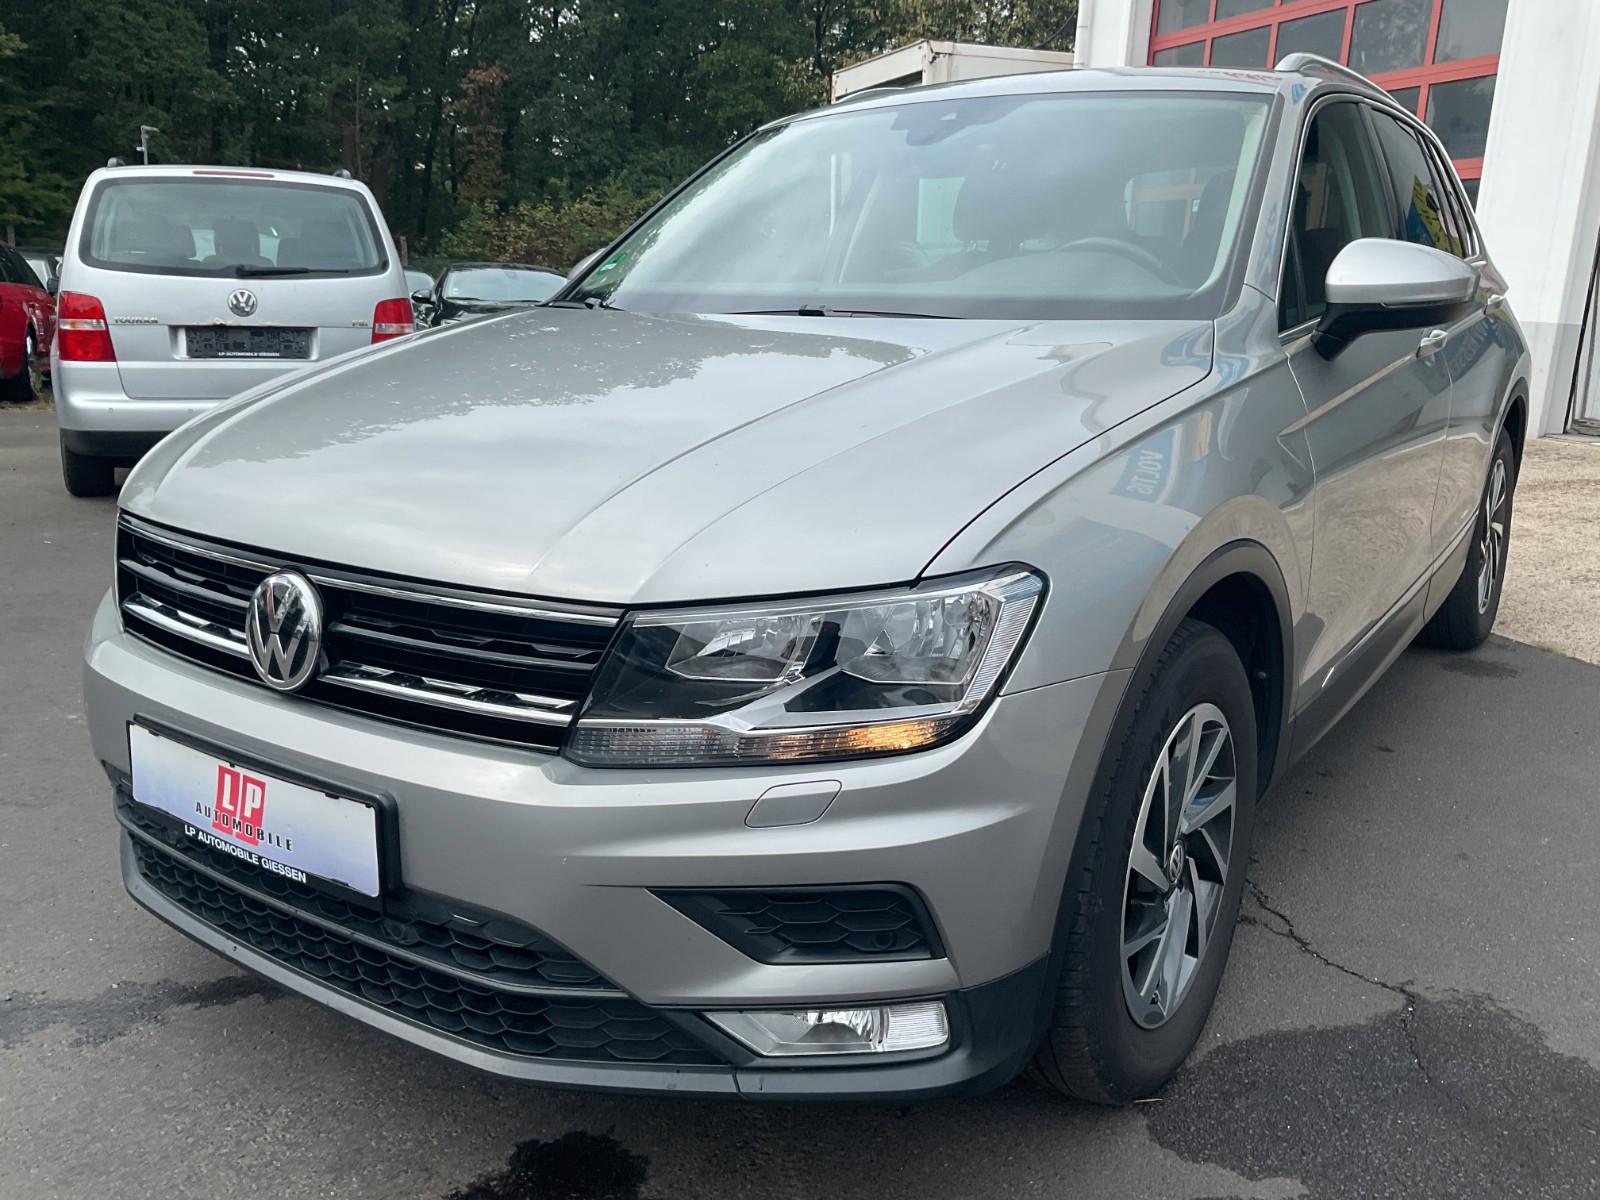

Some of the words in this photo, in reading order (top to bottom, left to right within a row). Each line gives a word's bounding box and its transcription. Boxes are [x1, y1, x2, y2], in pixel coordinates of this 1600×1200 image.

[222, 772, 262, 818] LP
[195, 801, 293, 852] AUTOMOBILE
[184, 823, 196, 837] LP
[198, 830, 259, 865] AUTOMOBILE
[261, 857, 307, 883] GIESSEN
